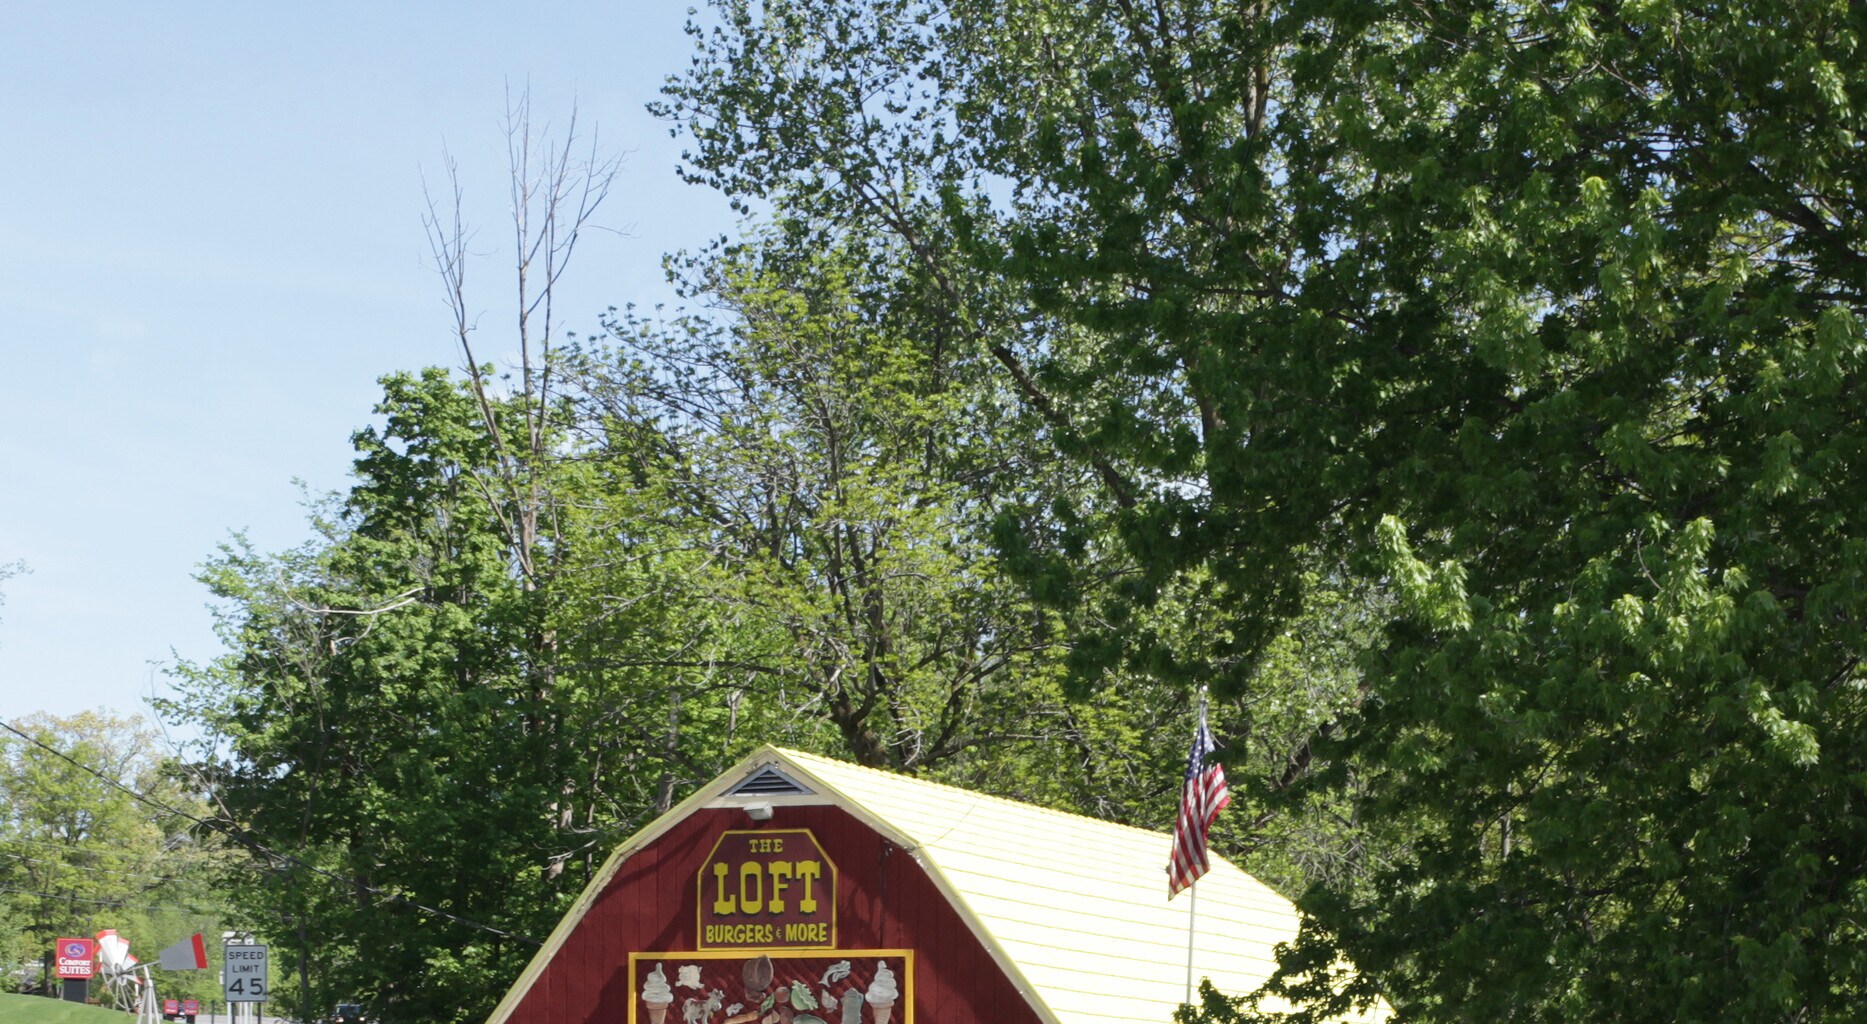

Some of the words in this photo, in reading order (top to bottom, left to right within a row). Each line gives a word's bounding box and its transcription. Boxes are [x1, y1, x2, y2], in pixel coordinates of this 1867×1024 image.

[749, 839, 783, 853] THE
[713, 860, 821, 915] LOFT
[705, 923, 774, 944] BURGERS
[785, 922, 828, 943] MORE
[228, 951, 264, 960] SPEED
[59, 966, 91, 975] SUITES
[232, 964, 260, 973] LIMIT
[228, 977, 264, 996] 45
